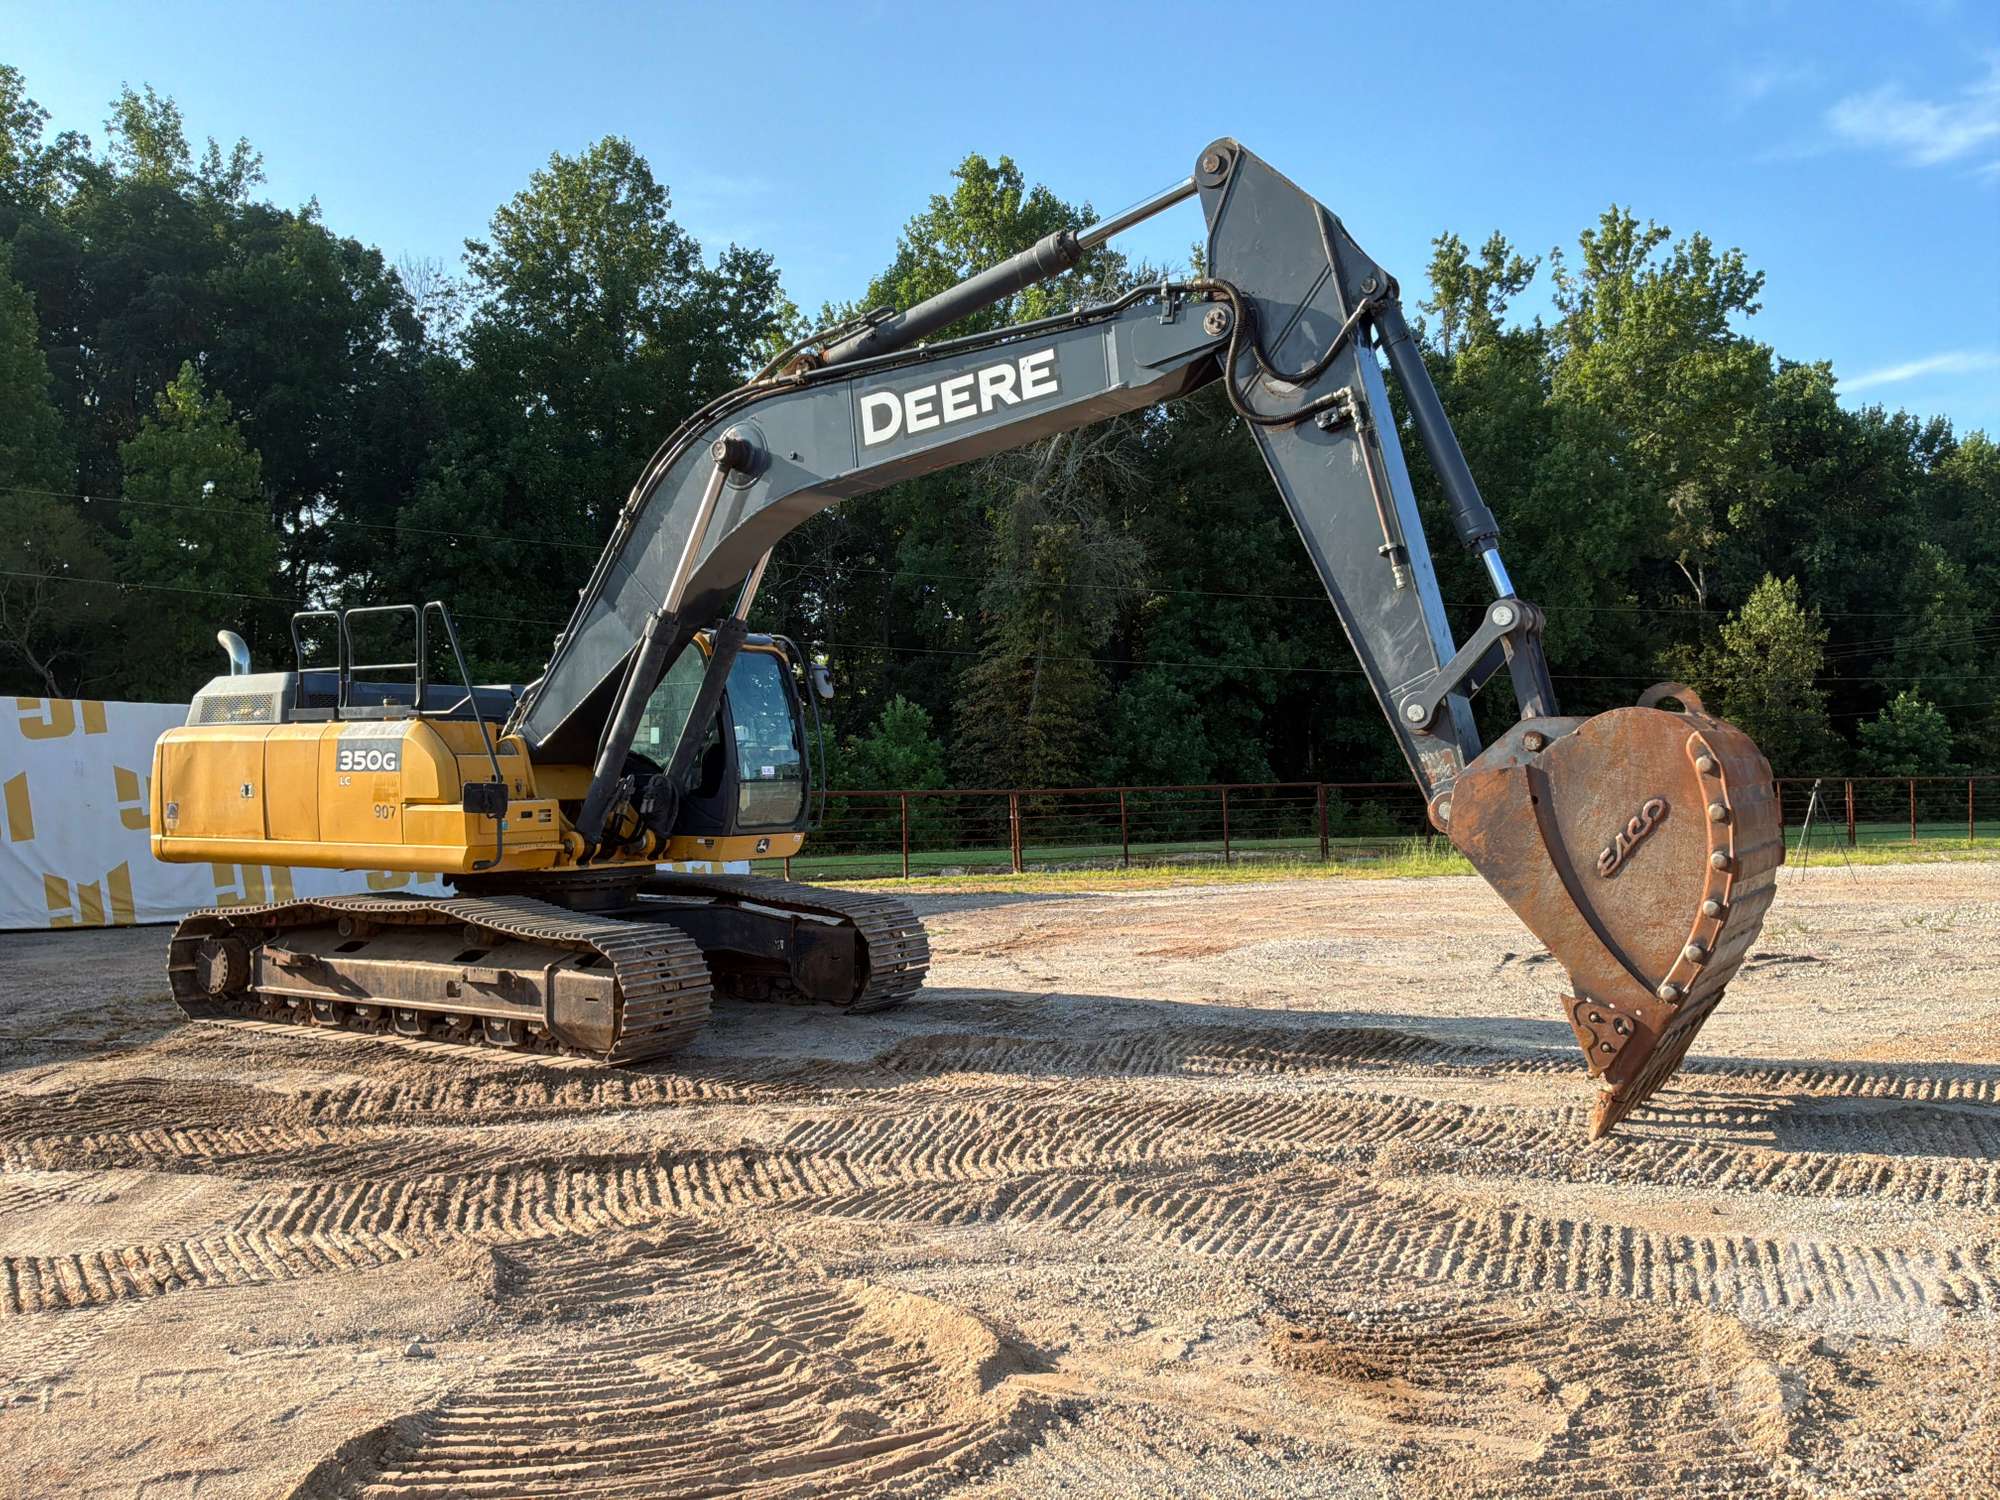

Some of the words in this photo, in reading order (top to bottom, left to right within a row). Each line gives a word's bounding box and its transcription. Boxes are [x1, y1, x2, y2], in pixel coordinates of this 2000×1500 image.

[860, 348, 1058, 446] DEERE
[340, 750, 396, 771] 350G
[339, 776, 352, 786] LC
[374, 804, 397, 820] 907
